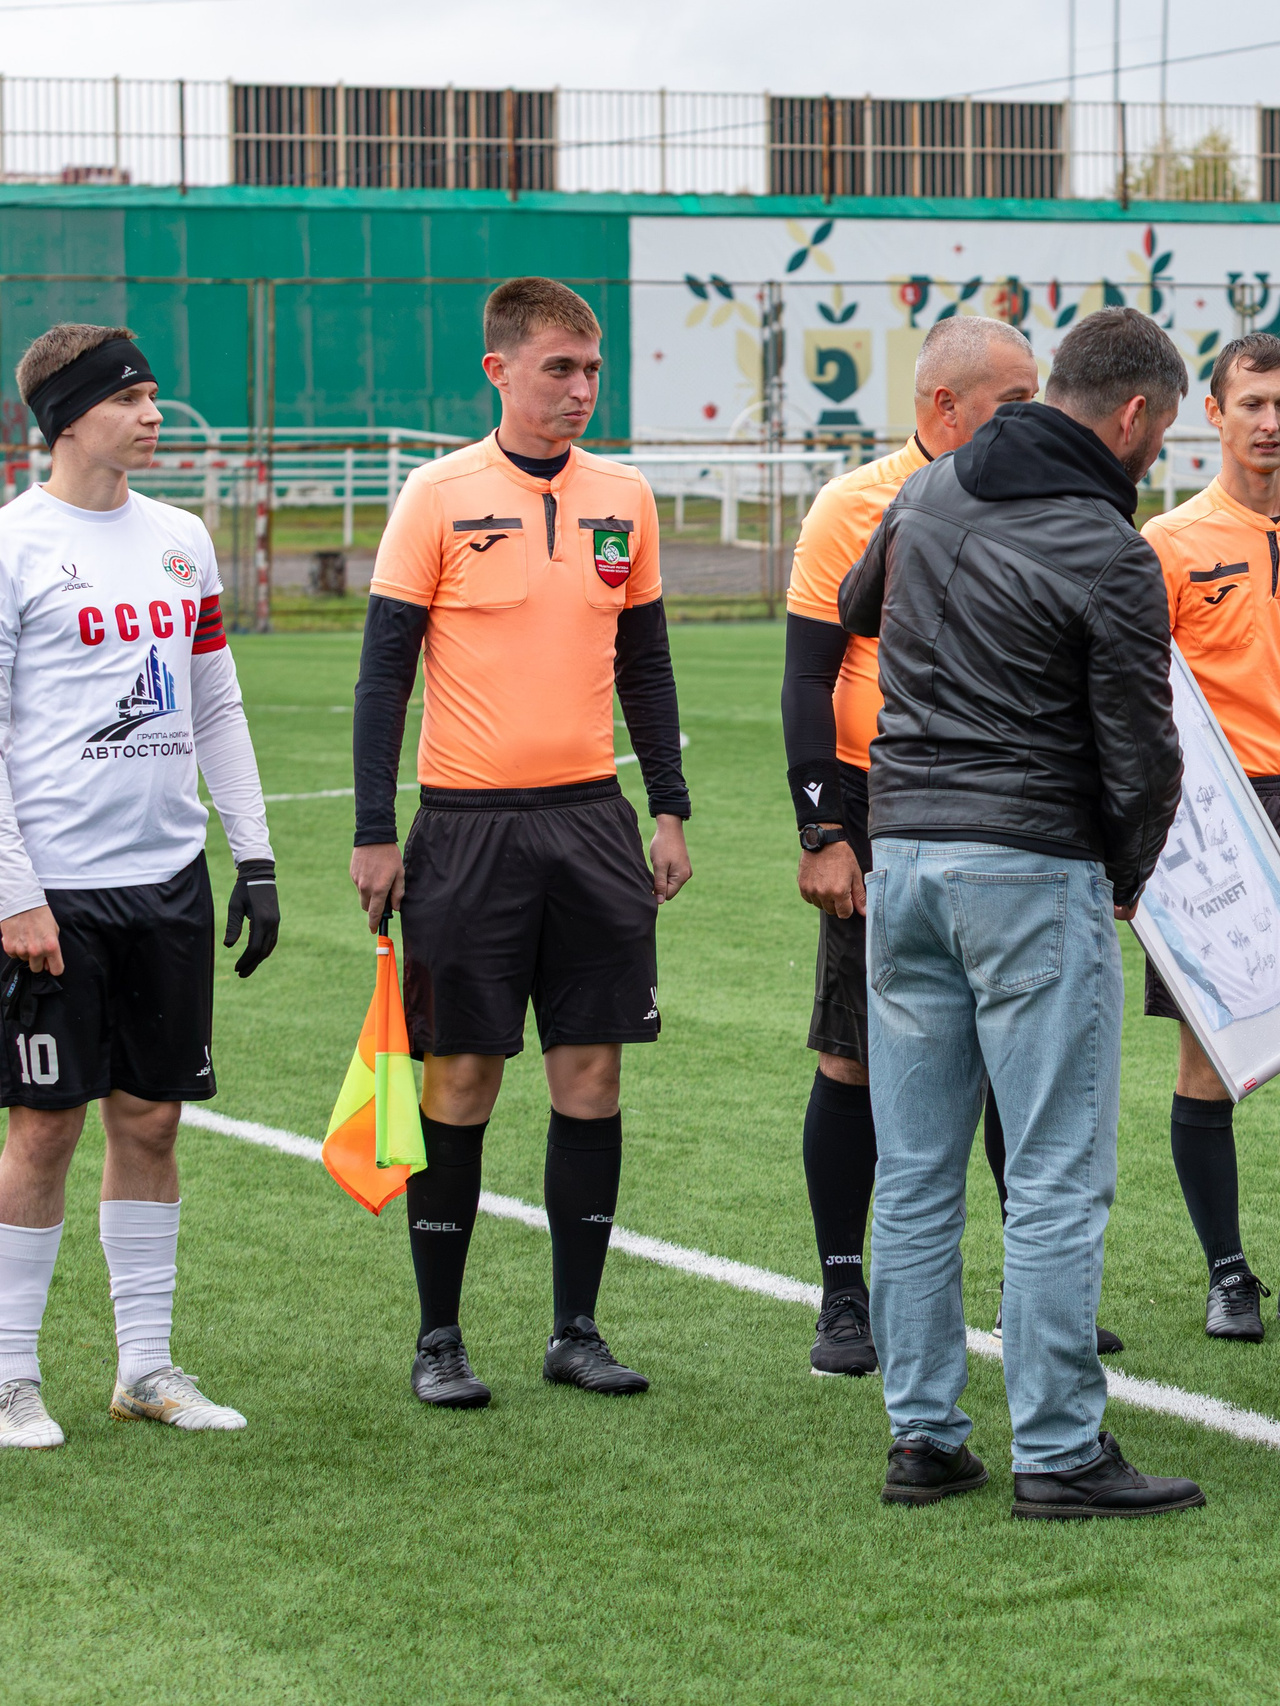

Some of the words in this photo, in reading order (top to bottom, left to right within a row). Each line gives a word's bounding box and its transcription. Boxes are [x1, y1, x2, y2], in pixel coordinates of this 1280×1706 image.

[61, 582, 94, 592] JÖGEL
[78, 599, 197, 646] СССР
[136, 732, 168, 741] ГРУППА
[1197, 880, 1247, 919] TATNEFT
[16, 1033, 60, 1085] 10
[412, 1219, 463, 1232] JÖGEL
